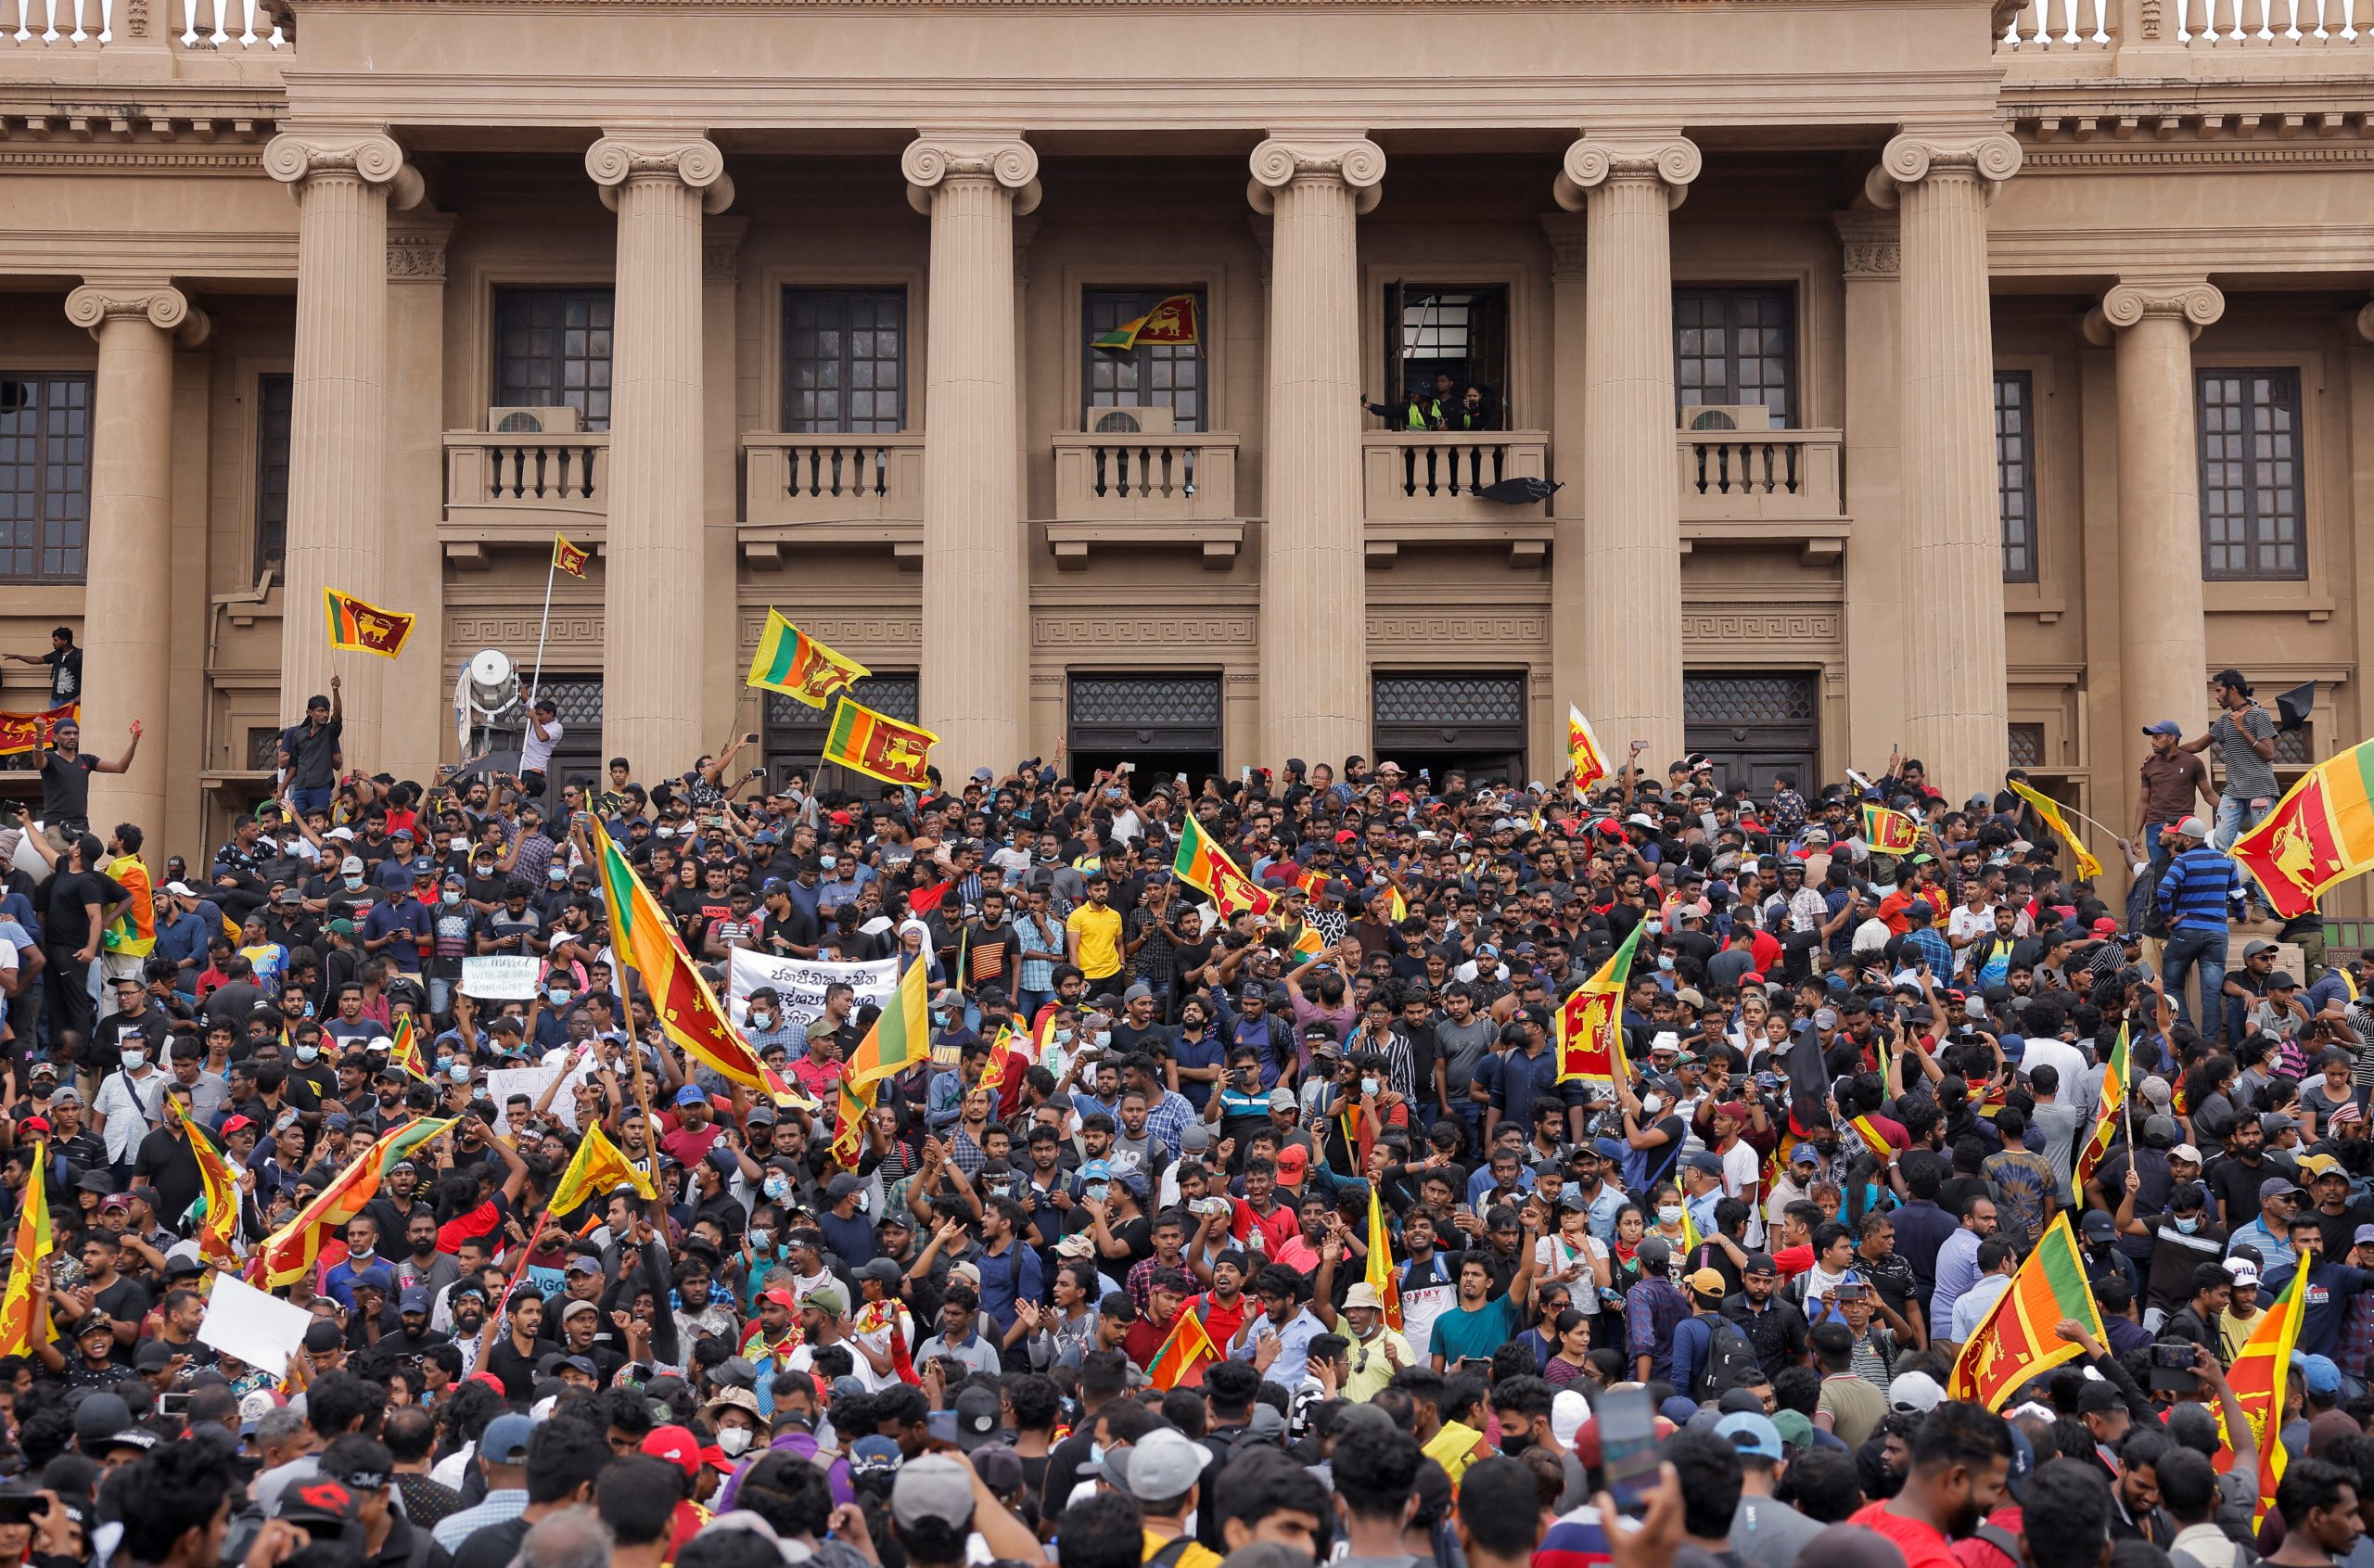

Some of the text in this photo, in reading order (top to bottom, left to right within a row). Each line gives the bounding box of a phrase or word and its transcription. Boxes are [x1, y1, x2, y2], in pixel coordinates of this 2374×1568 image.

[497, 1072, 528, 1090] WE
[2234, 1267, 2256, 1278] FILA
[534, 1278, 565, 1292] UGO
